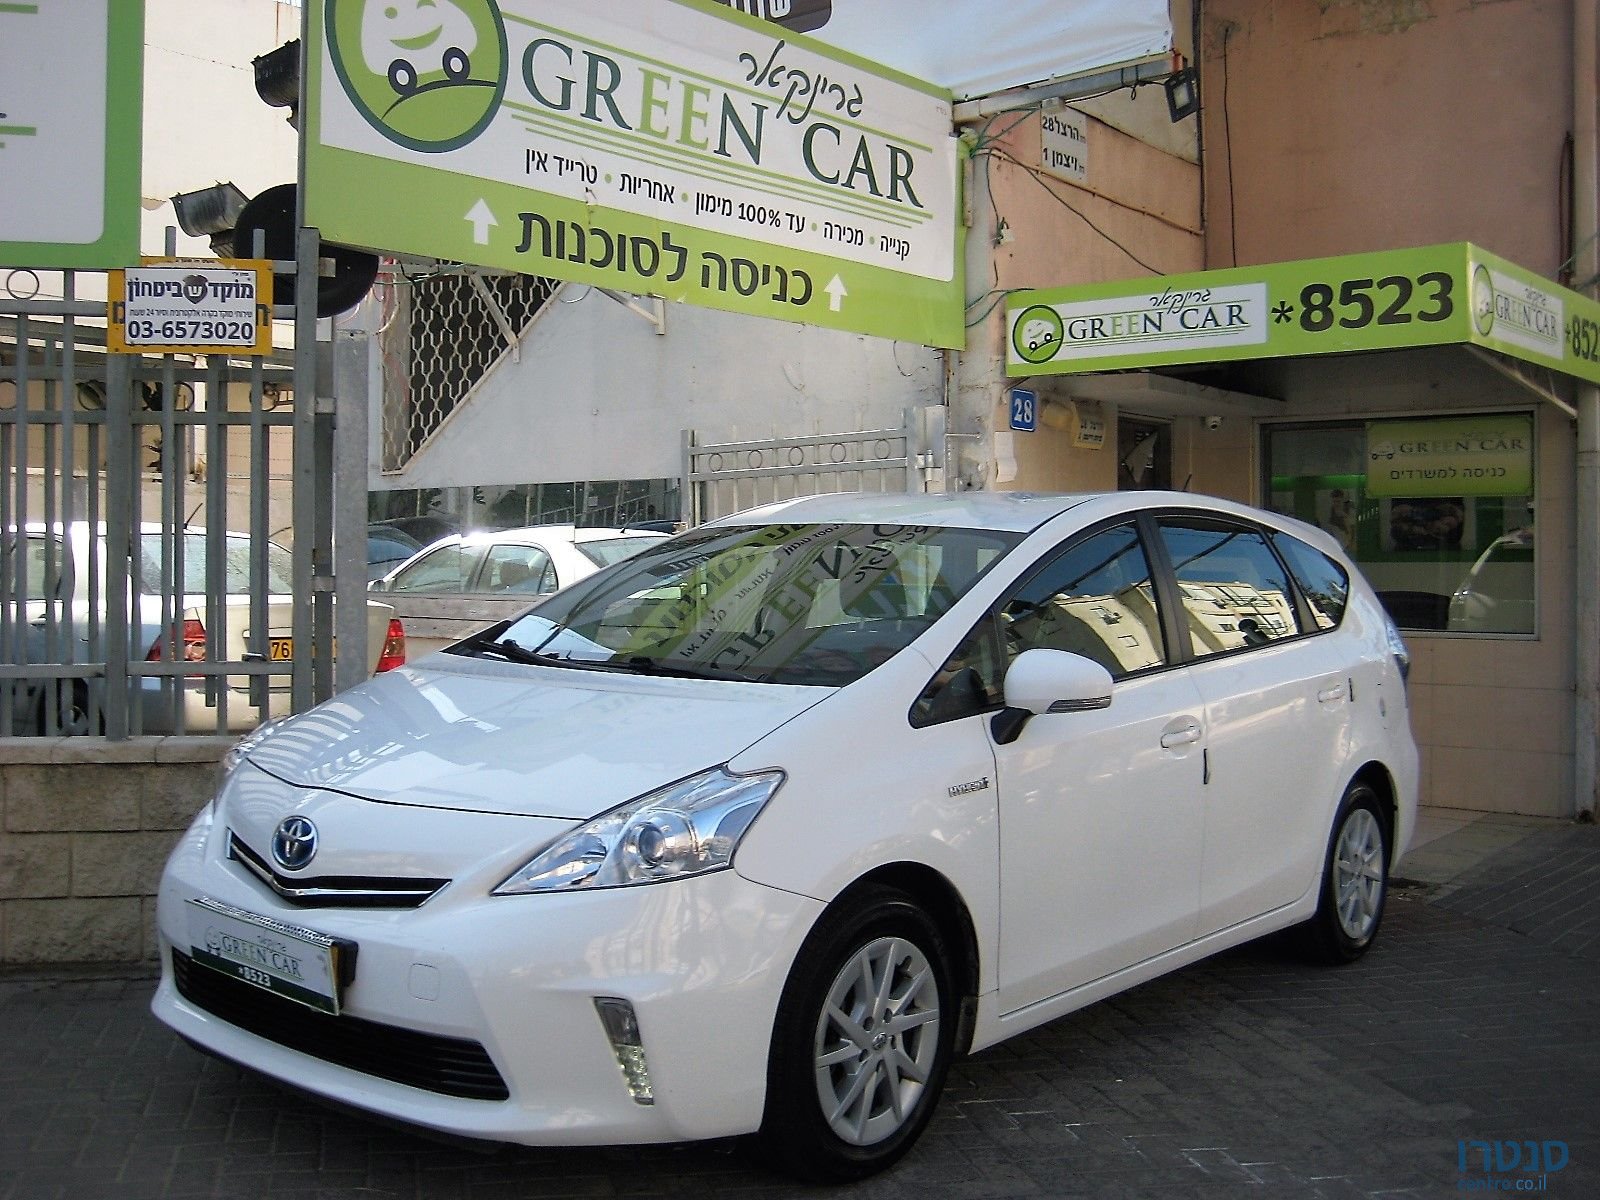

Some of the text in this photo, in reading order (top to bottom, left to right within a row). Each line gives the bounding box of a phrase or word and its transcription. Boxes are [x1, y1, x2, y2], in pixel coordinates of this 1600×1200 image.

[739, 39, 863, 125] גרינקאר
[521, 38, 923, 208] GREEN CAR
[1043, 147, 1048, 160] 1
[525, 147, 911, 260] קנייה מכירה עד 100% מימון אחריות טרייד אין
[515, 212, 813, 306] כניסה לסוכנות
[146, 308, 154, 316] 24
[1068, 311, 1164, 340] GREEN
[1180, 304, 1249, 330] CAR
[1495, 294, 1531, 328] GREEN
[1535, 310, 1558, 337] CAR
[128, 321, 253, 340] 03-6573020
[1014, 398, 1033, 423] 28
[1400, 438, 1524, 453] GREEN CAR
[1390, 466, 1506, 480] כניסה למשרדים
[222, 936, 267, 964] GREEN
[272, 953, 301, 978] CAR
